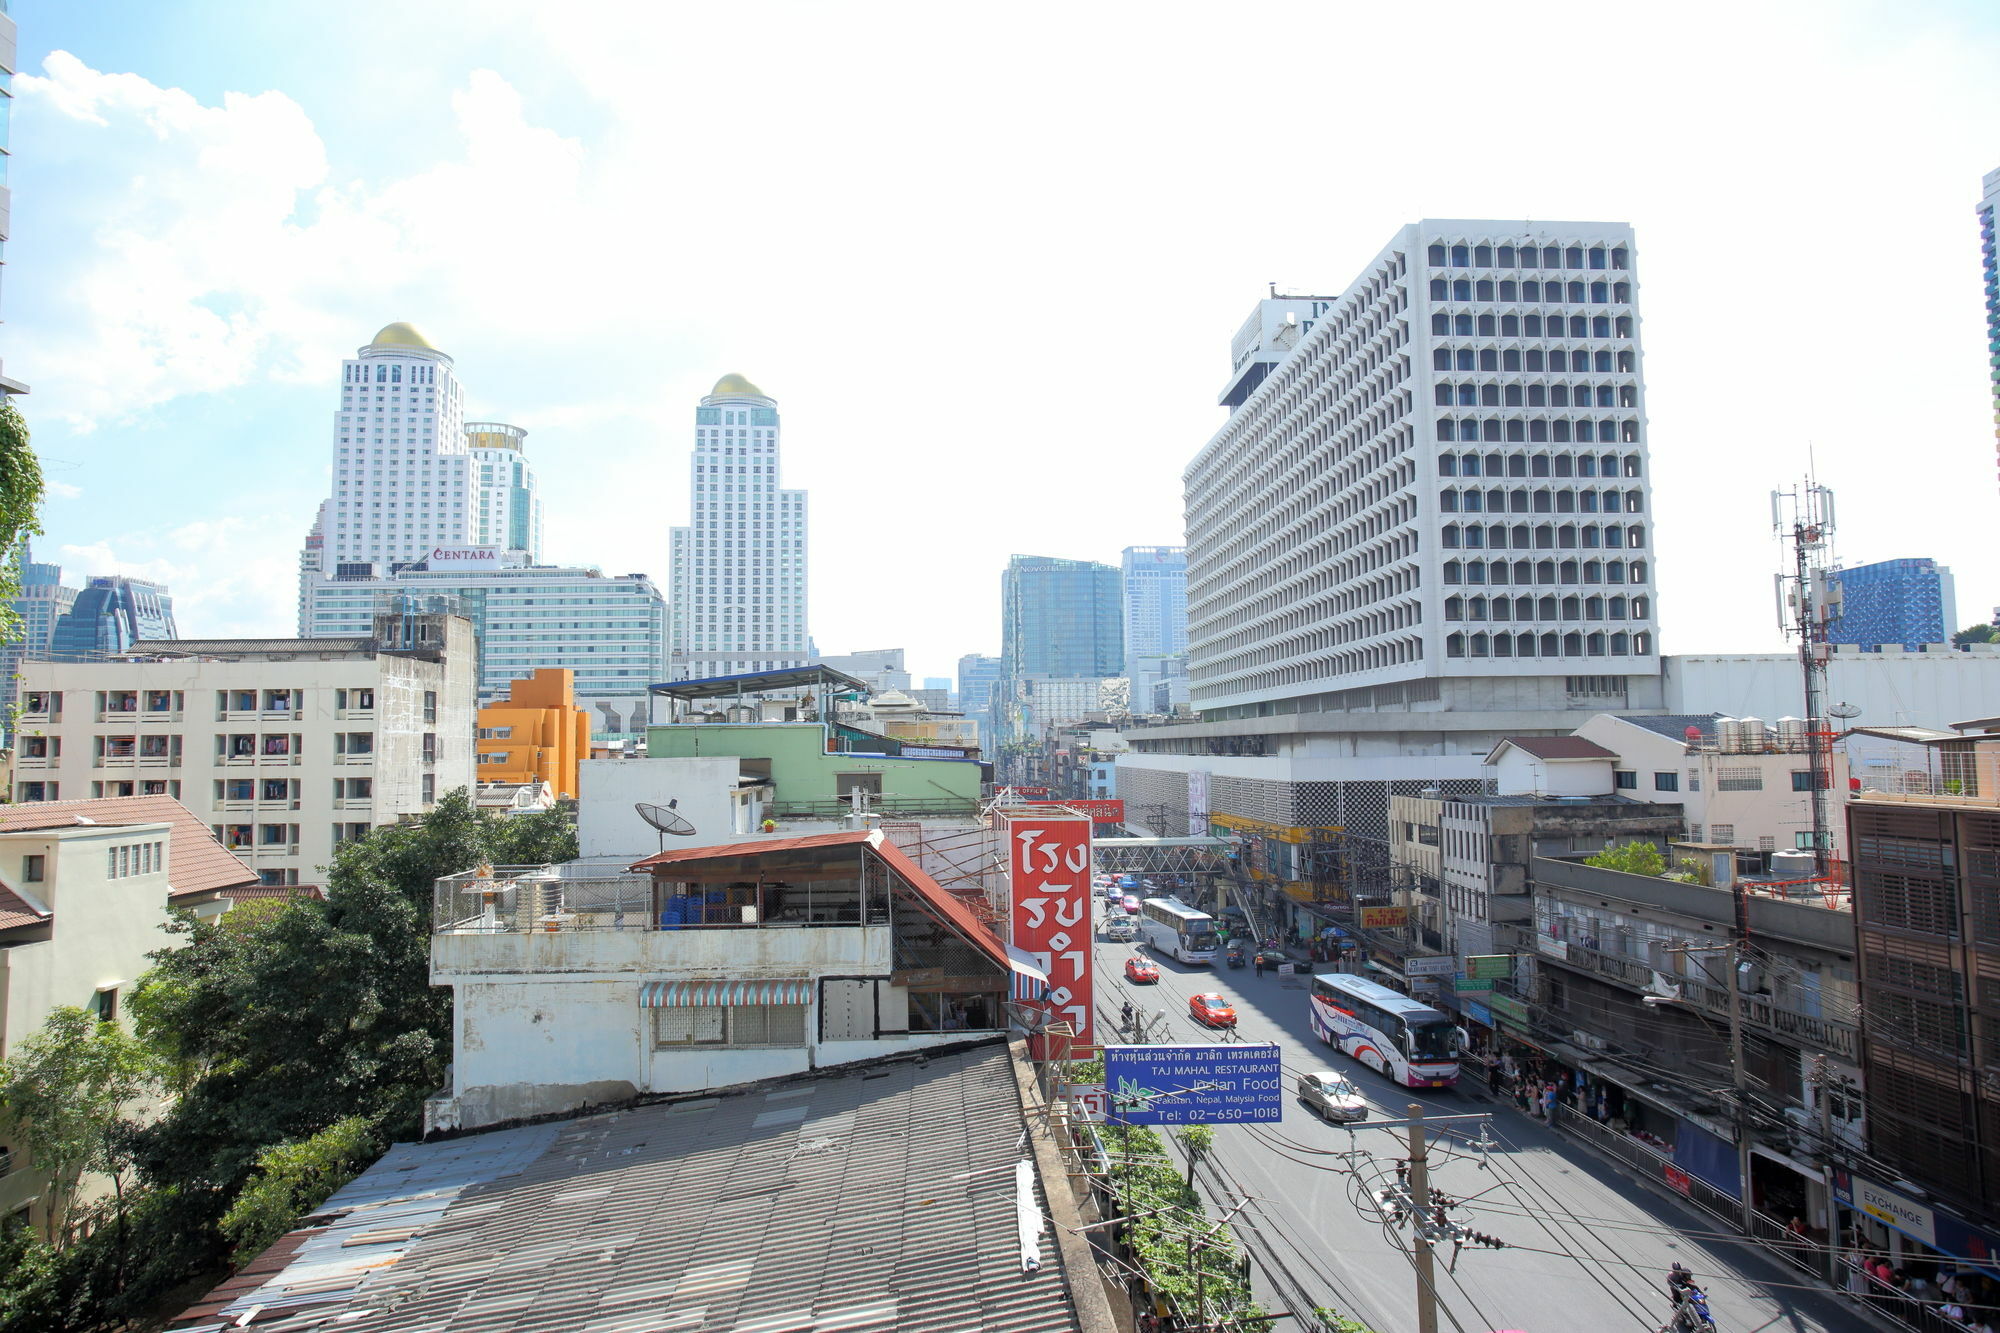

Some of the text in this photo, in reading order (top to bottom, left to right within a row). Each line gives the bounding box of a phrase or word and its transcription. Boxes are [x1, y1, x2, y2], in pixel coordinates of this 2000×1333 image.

[433, 548, 495, 560] CENTARA
[1111, 1050, 1191, 1064] ห้างหุ้นส่วนจำกัด
[1195, 1050, 1222, 1061] มาลิก
[1152, 1064, 1279, 1075] TAJ MAHAL RESTAURANT
[1193, 1077, 1279, 1091] Indian Food
[1196, 1095, 1222, 1105] Nepal,
[1258, 1094, 1280, 1102] Food
[1158, 1108, 1279, 1121] Tel: 02-650-1018
[1864, 1190, 1923, 1226] EXCHANGE
